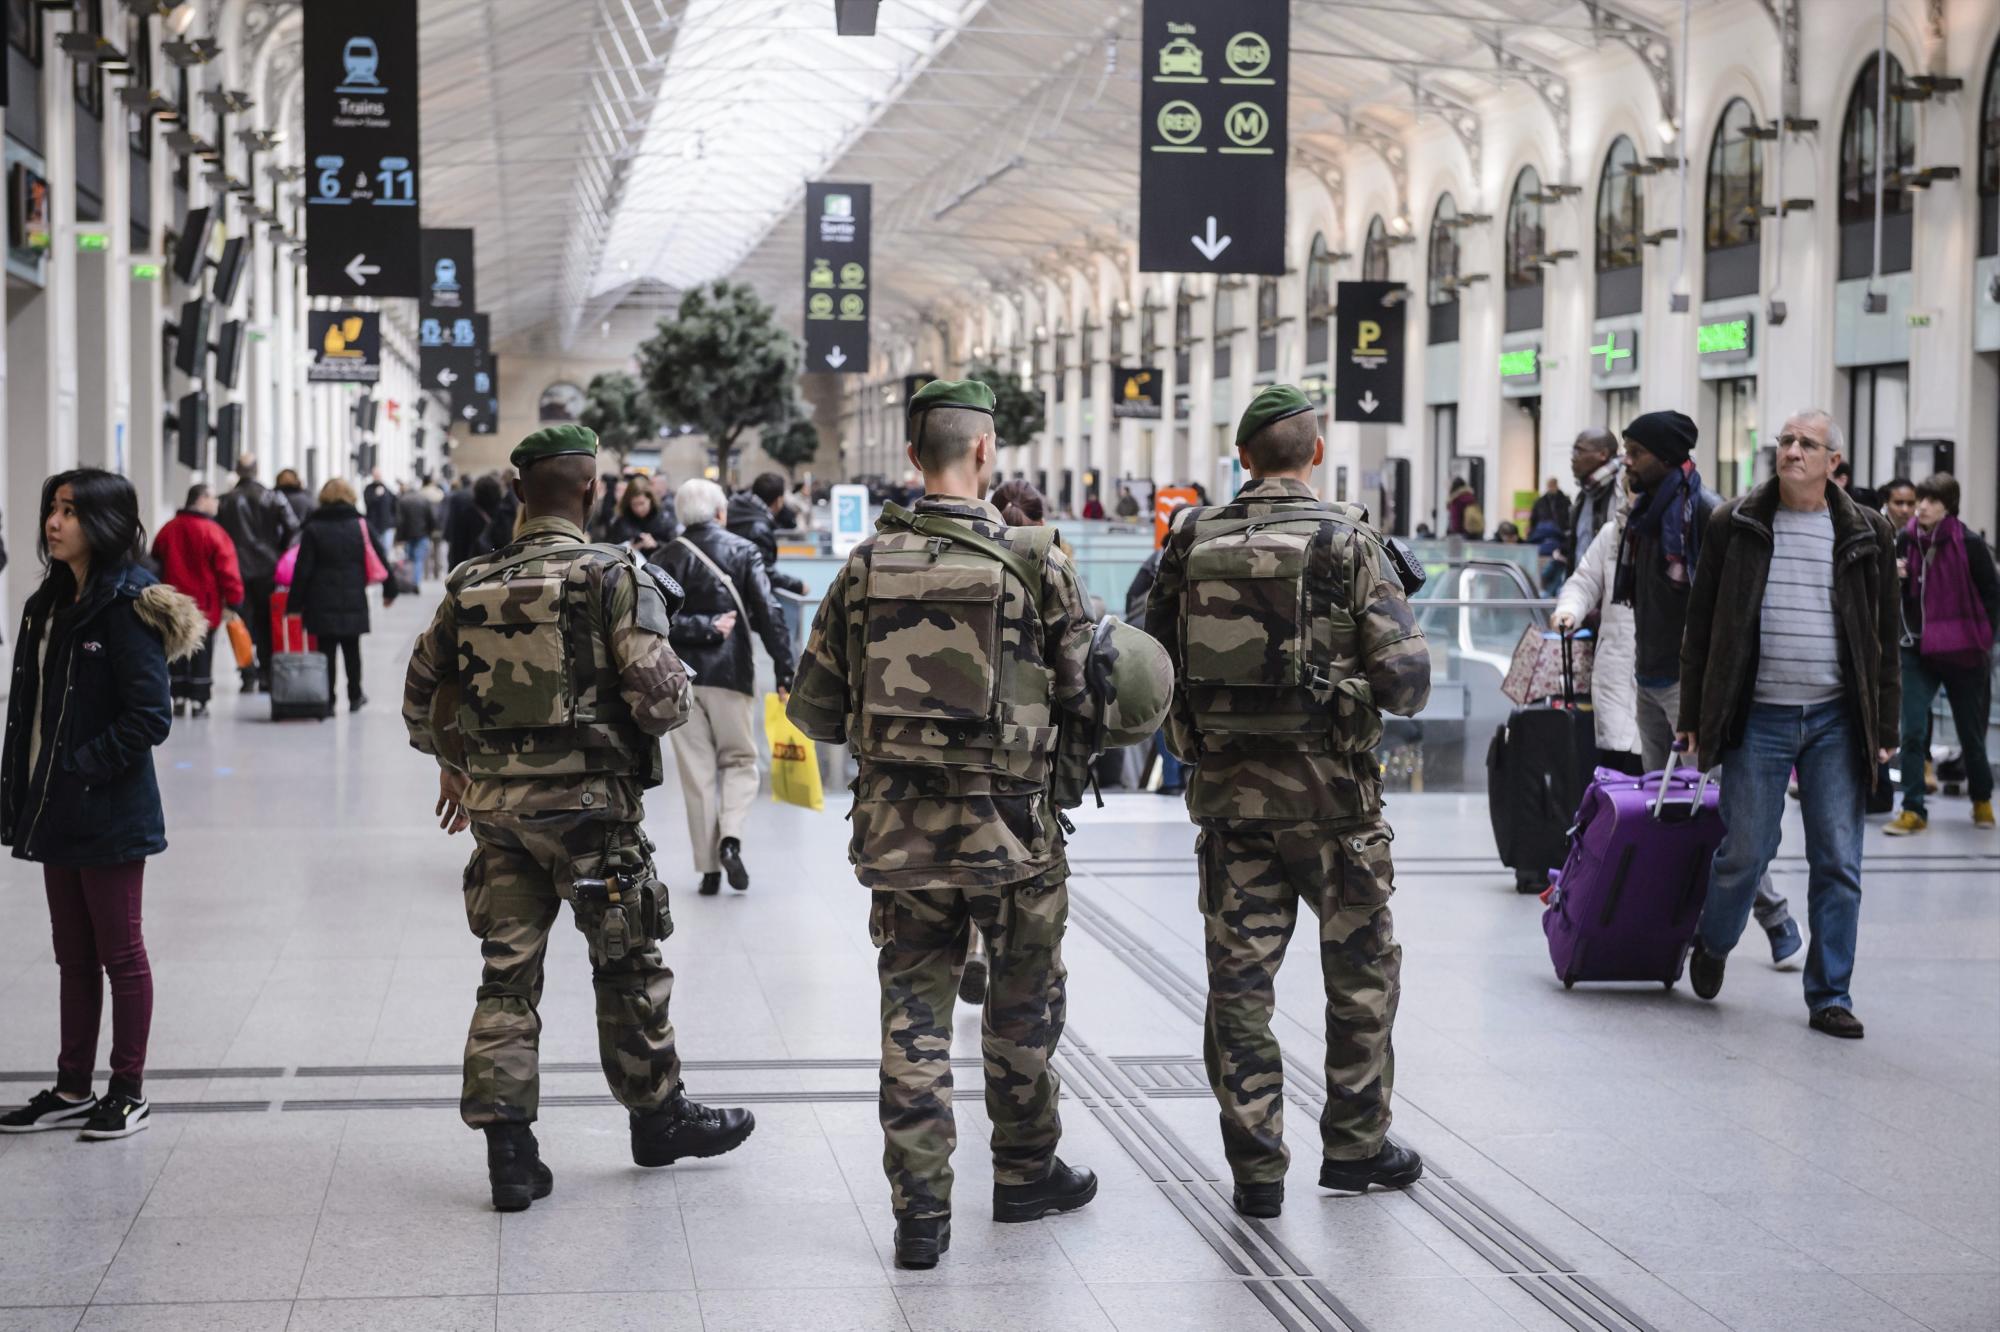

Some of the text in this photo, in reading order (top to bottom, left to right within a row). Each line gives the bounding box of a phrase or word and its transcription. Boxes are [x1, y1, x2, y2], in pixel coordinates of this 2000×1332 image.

[1231, 45, 1265, 63] BUS
[338, 98, 385, 116] Trains
[1163, 112, 1197, 131] RER
[1234, 110, 1260, 137] M
[319, 169, 341, 199] 6
[376, 169, 413, 199] 11
[1358, 320, 1381, 350] P
